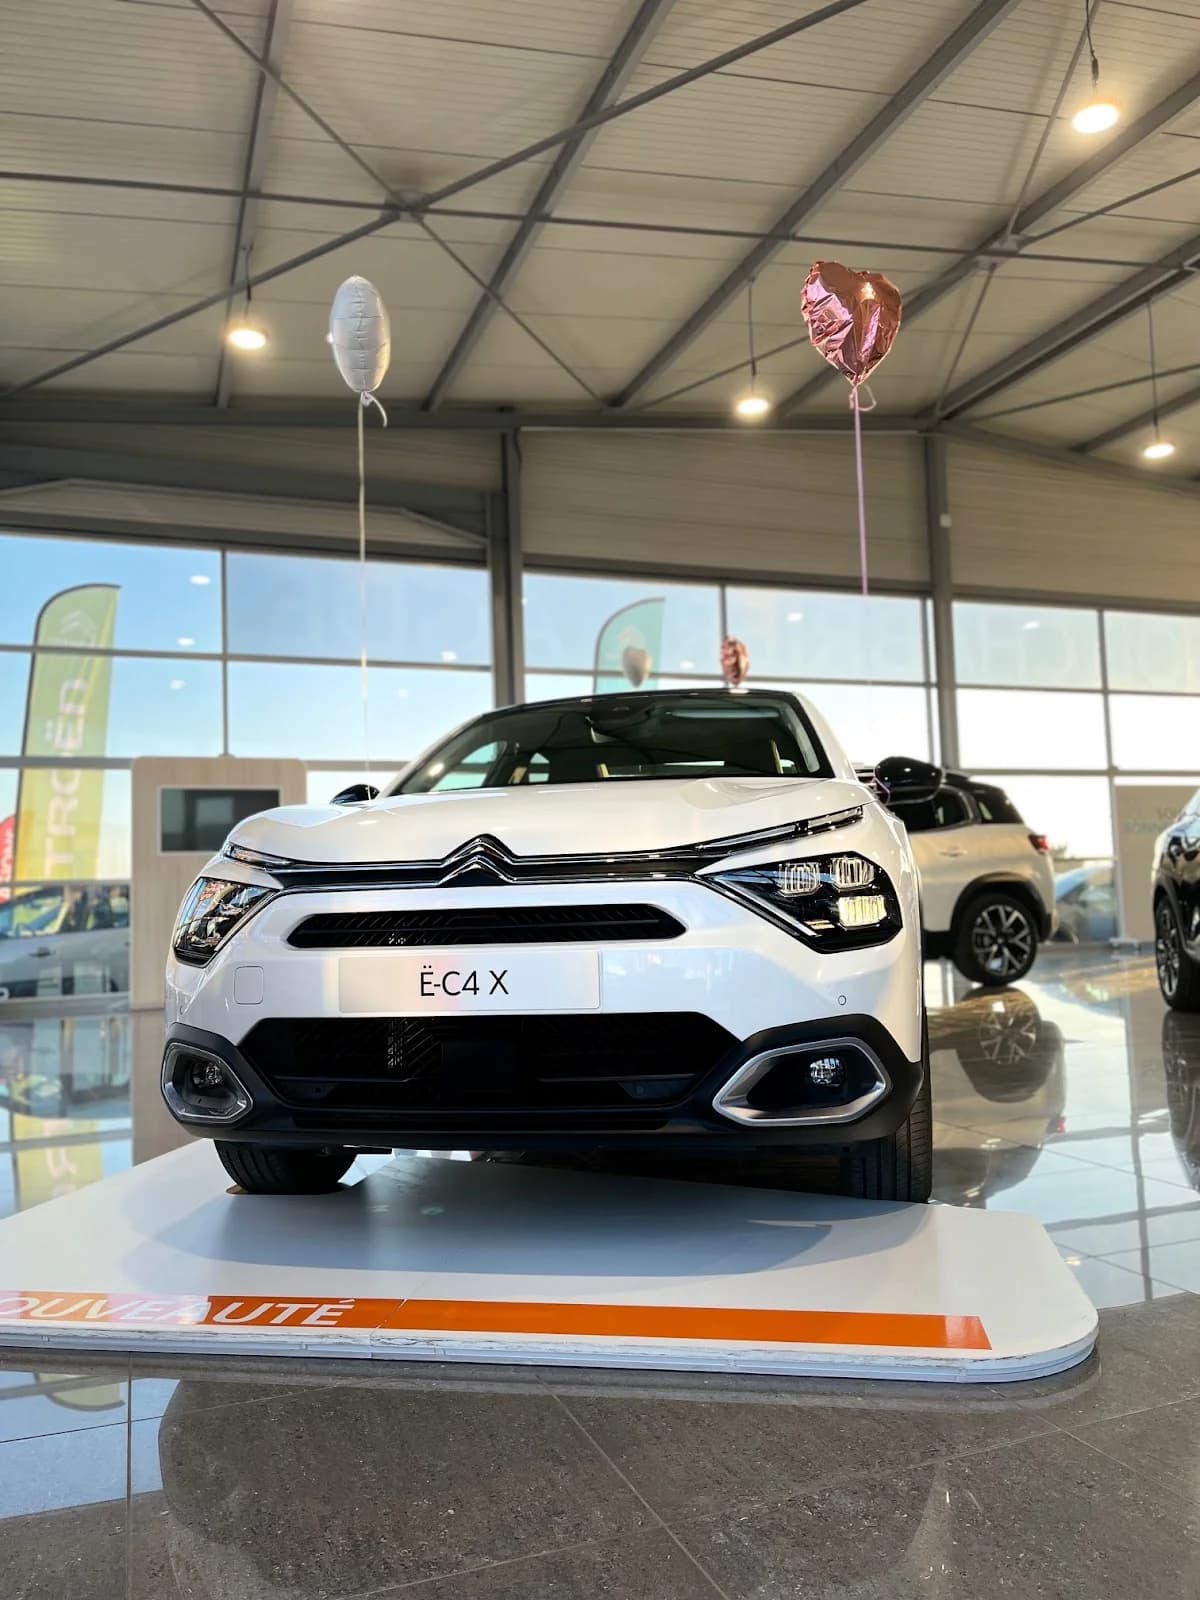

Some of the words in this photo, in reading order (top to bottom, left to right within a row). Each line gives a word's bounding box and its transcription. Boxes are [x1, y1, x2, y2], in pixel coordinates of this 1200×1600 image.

[419, 964, 480, 997] Ë-C4
[488, 969, 509, 996] X
[0, 1297, 355, 1327] OUVEAUTÉ
